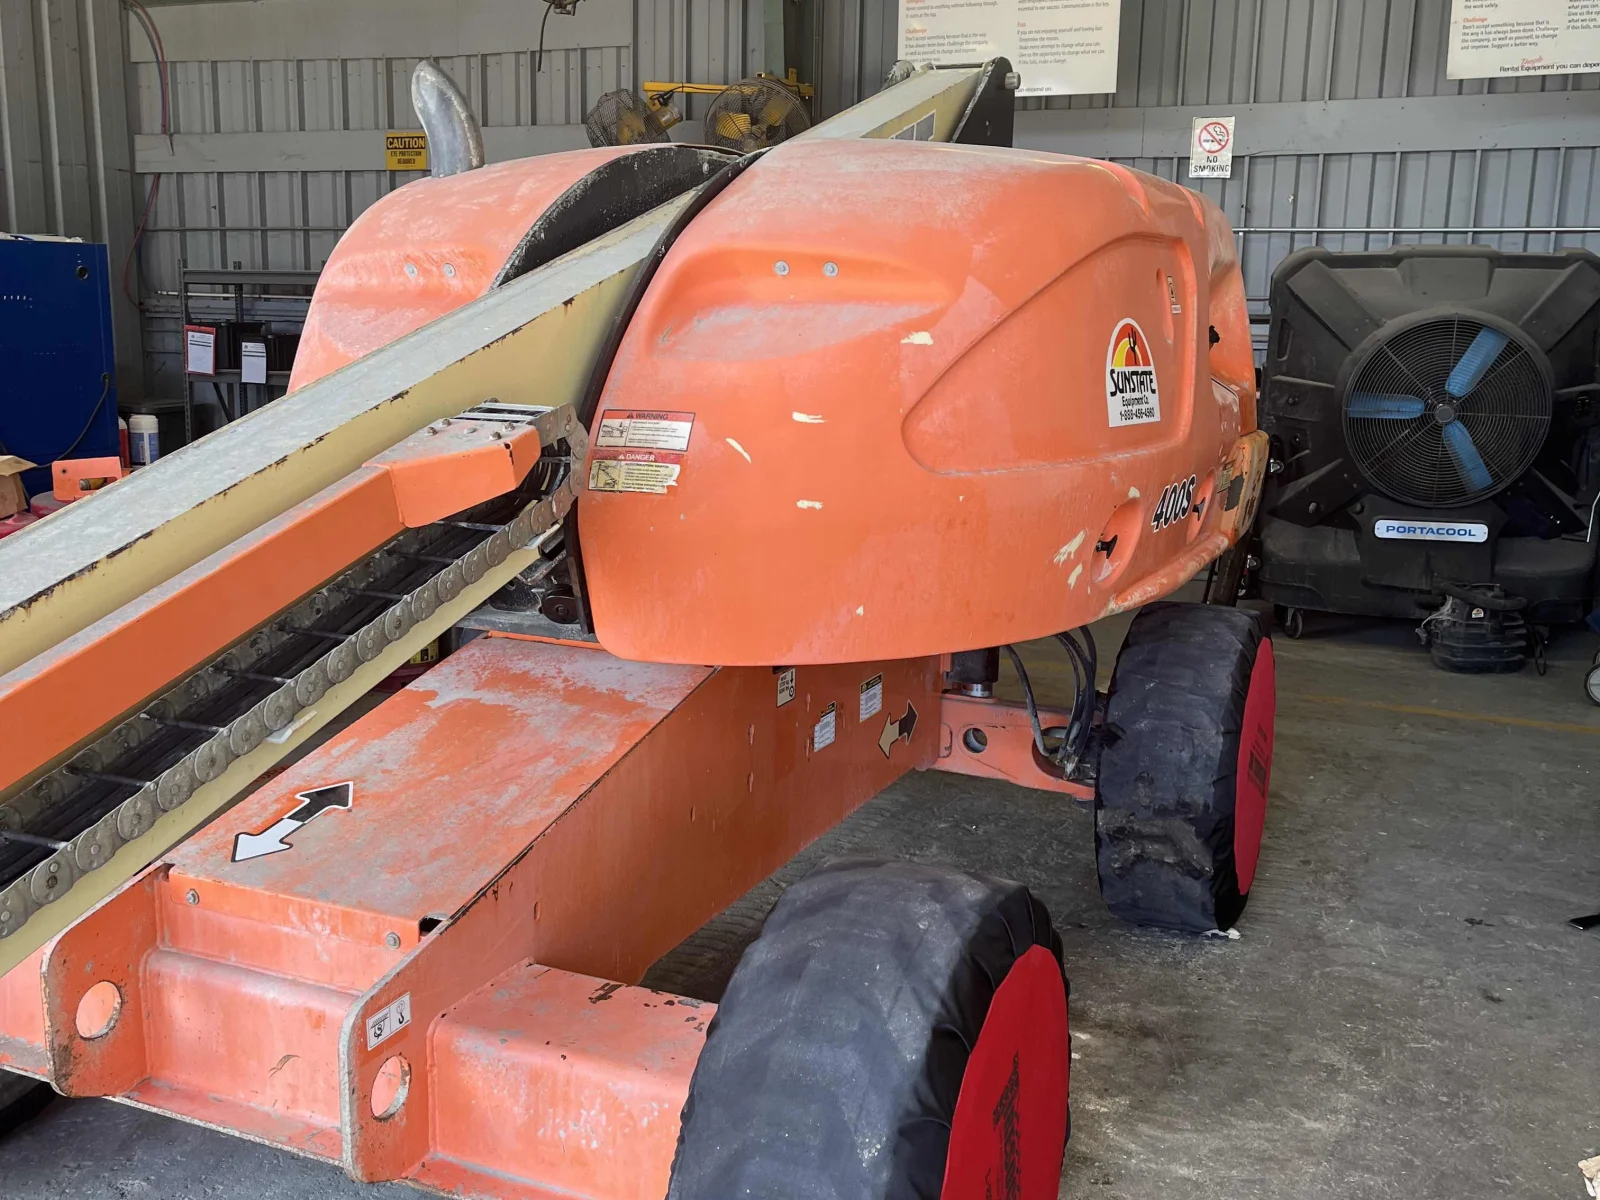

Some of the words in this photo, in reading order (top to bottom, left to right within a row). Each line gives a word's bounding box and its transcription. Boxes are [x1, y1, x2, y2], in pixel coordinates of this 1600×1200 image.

[388, 138, 424, 148] CAUTION
[1122, 396, 1144, 408] Equipment
[1151, 474, 1196, 533] 400S
[1386, 526, 1476, 536] PORTACOOL
